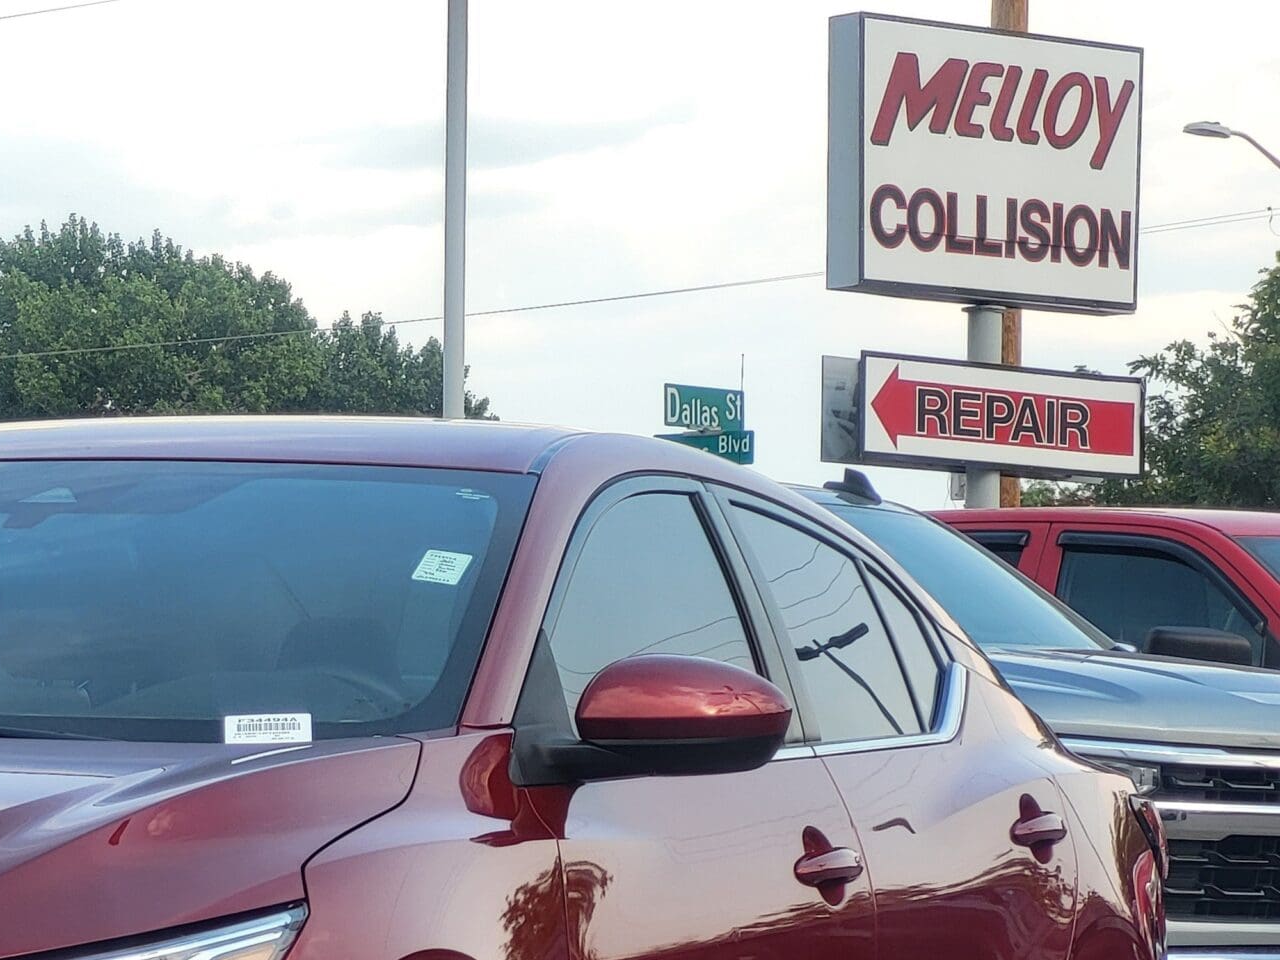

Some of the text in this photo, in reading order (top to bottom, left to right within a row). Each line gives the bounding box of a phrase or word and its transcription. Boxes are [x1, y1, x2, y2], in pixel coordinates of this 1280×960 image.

[871, 52, 1135, 170] MELLOY
[870, 184, 1131, 270] COLLISION
[666, 387, 741, 427] Dallas St
[916, 388, 1090, 449] REPAIR
[719, 435, 750, 453] Blvd
